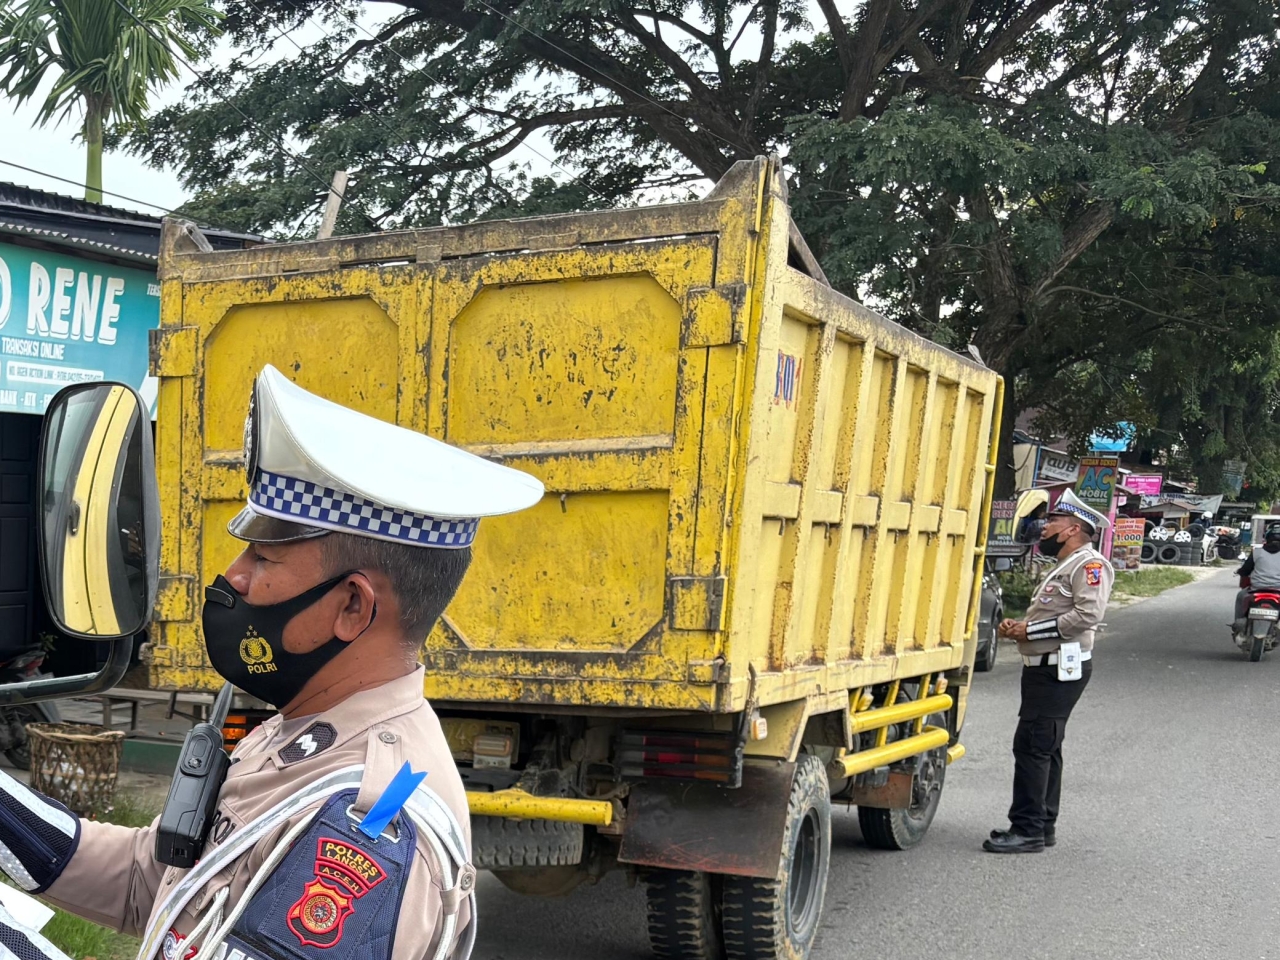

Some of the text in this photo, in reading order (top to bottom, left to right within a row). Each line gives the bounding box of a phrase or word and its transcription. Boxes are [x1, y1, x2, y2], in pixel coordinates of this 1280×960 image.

[26, 261, 125, 345] RENE
[2, 337, 39, 357] TRANSAKSI
[41, 343, 65, 361] ONLINE
[1080, 466, 1114, 491] AC
[1078, 490, 1108, 498] MOBIL
[1117, 533, 1142, 542] 1.000
[247, 662, 278, 674] POLRI
[325, 842, 378, 876] POLRES
[326, 851, 369, 880] LANGSA
